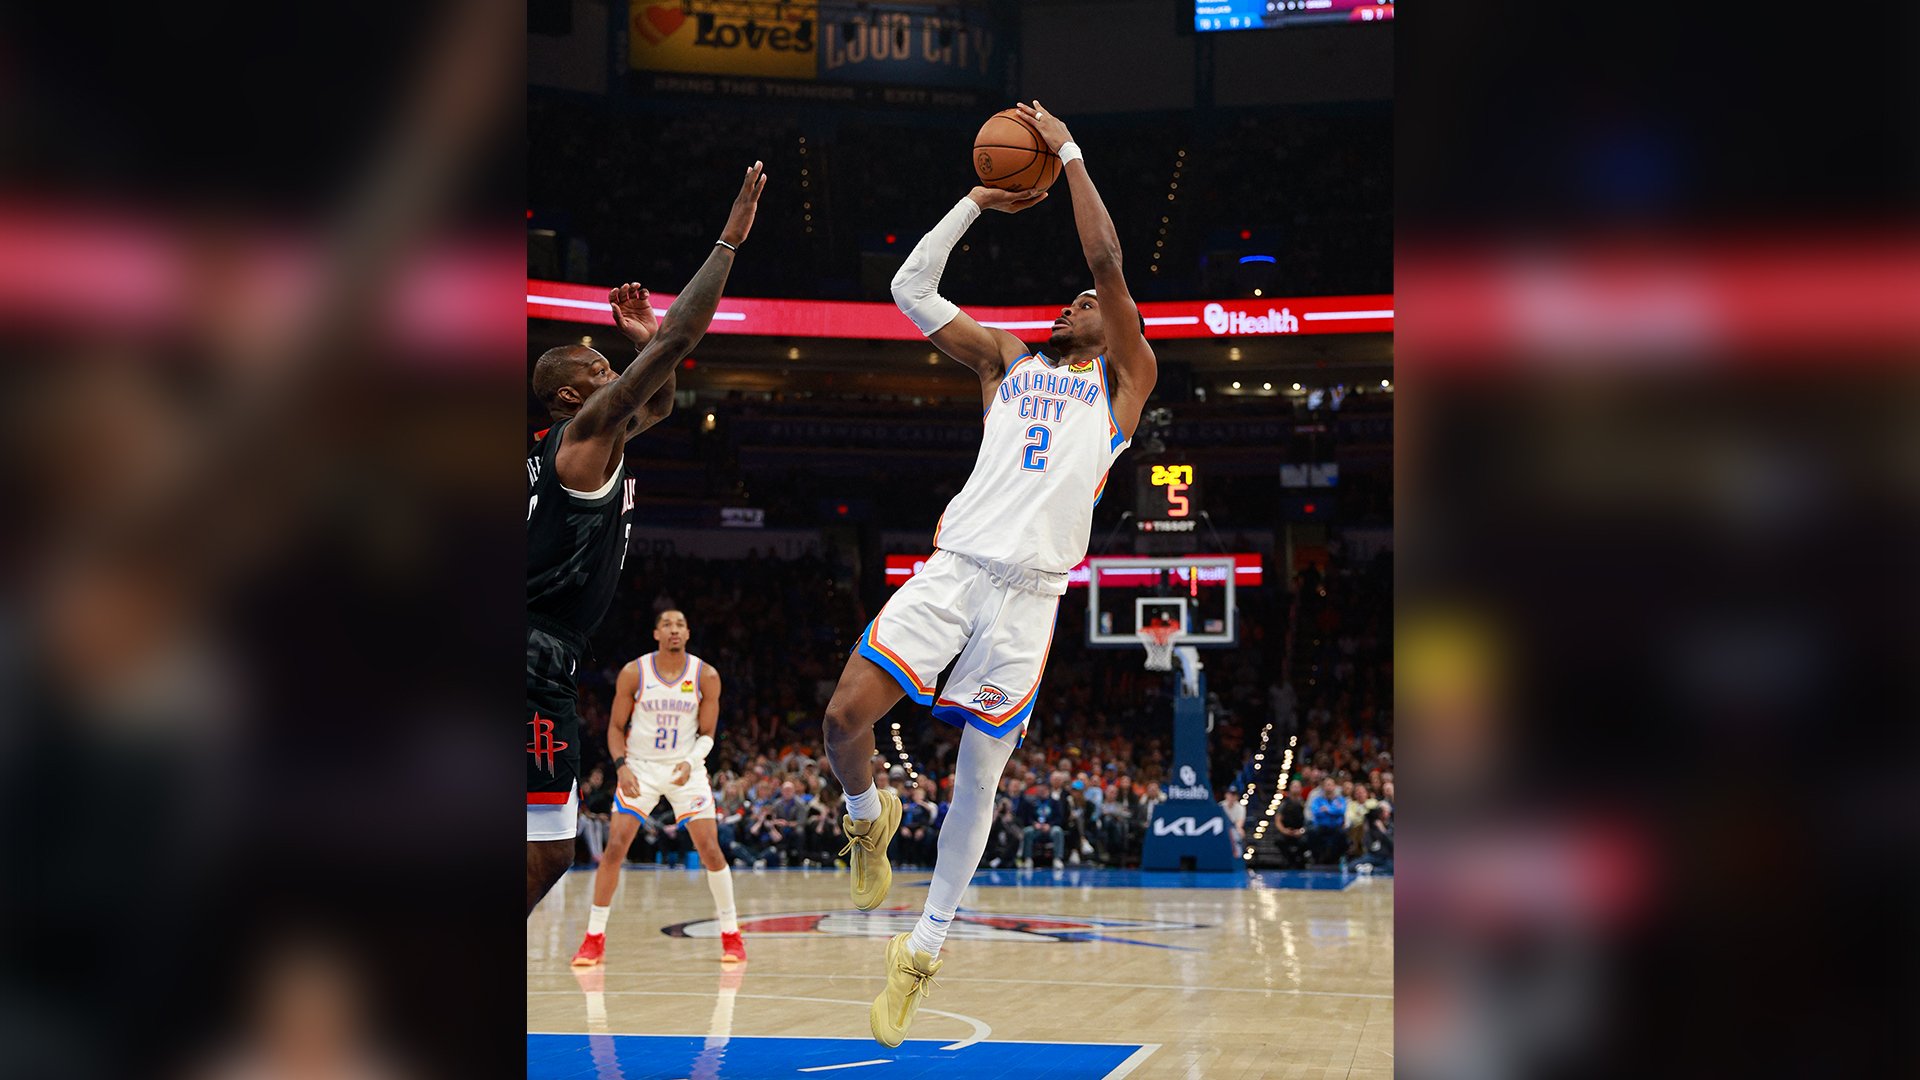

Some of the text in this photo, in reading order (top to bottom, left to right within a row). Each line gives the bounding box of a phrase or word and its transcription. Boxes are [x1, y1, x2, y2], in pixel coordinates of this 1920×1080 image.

[1229, 308, 1299, 334] Health
[999, 370, 1101, 407] OKLAHOMA
[1018, 395, 1067, 423] CITY
[1020, 423, 1052, 472] 2
[1167, 483, 1189, 517] 5
[656, 713, 680, 726] CITY
[655, 728, 678, 749] 21
[1168, 784, 1209, 800] Health
